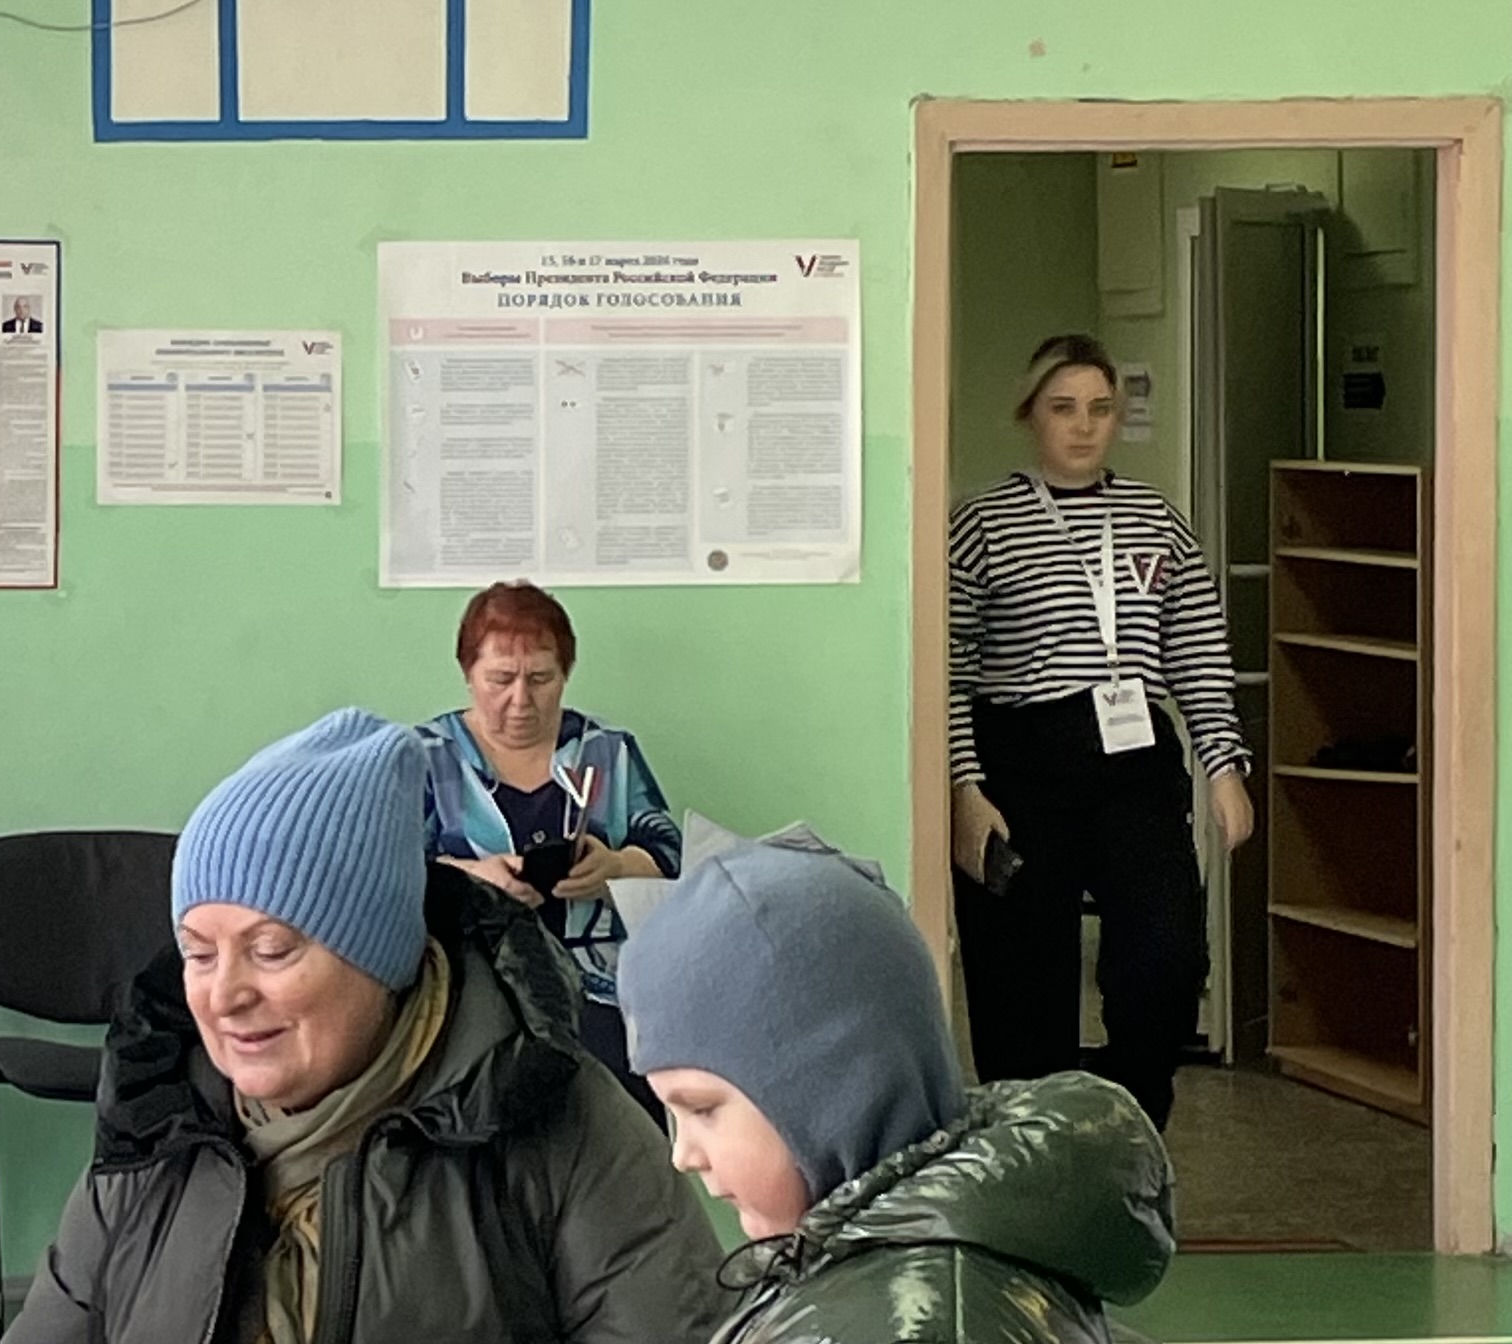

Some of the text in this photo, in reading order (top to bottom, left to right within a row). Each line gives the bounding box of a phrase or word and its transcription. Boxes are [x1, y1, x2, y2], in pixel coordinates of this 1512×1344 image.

[462, 270, 521, 287] Выборы
[525, 270, 610, 287] Президента
[497, 292, 742, 309] ПОРЯДОК ГОЛОСОВАНИЯ
